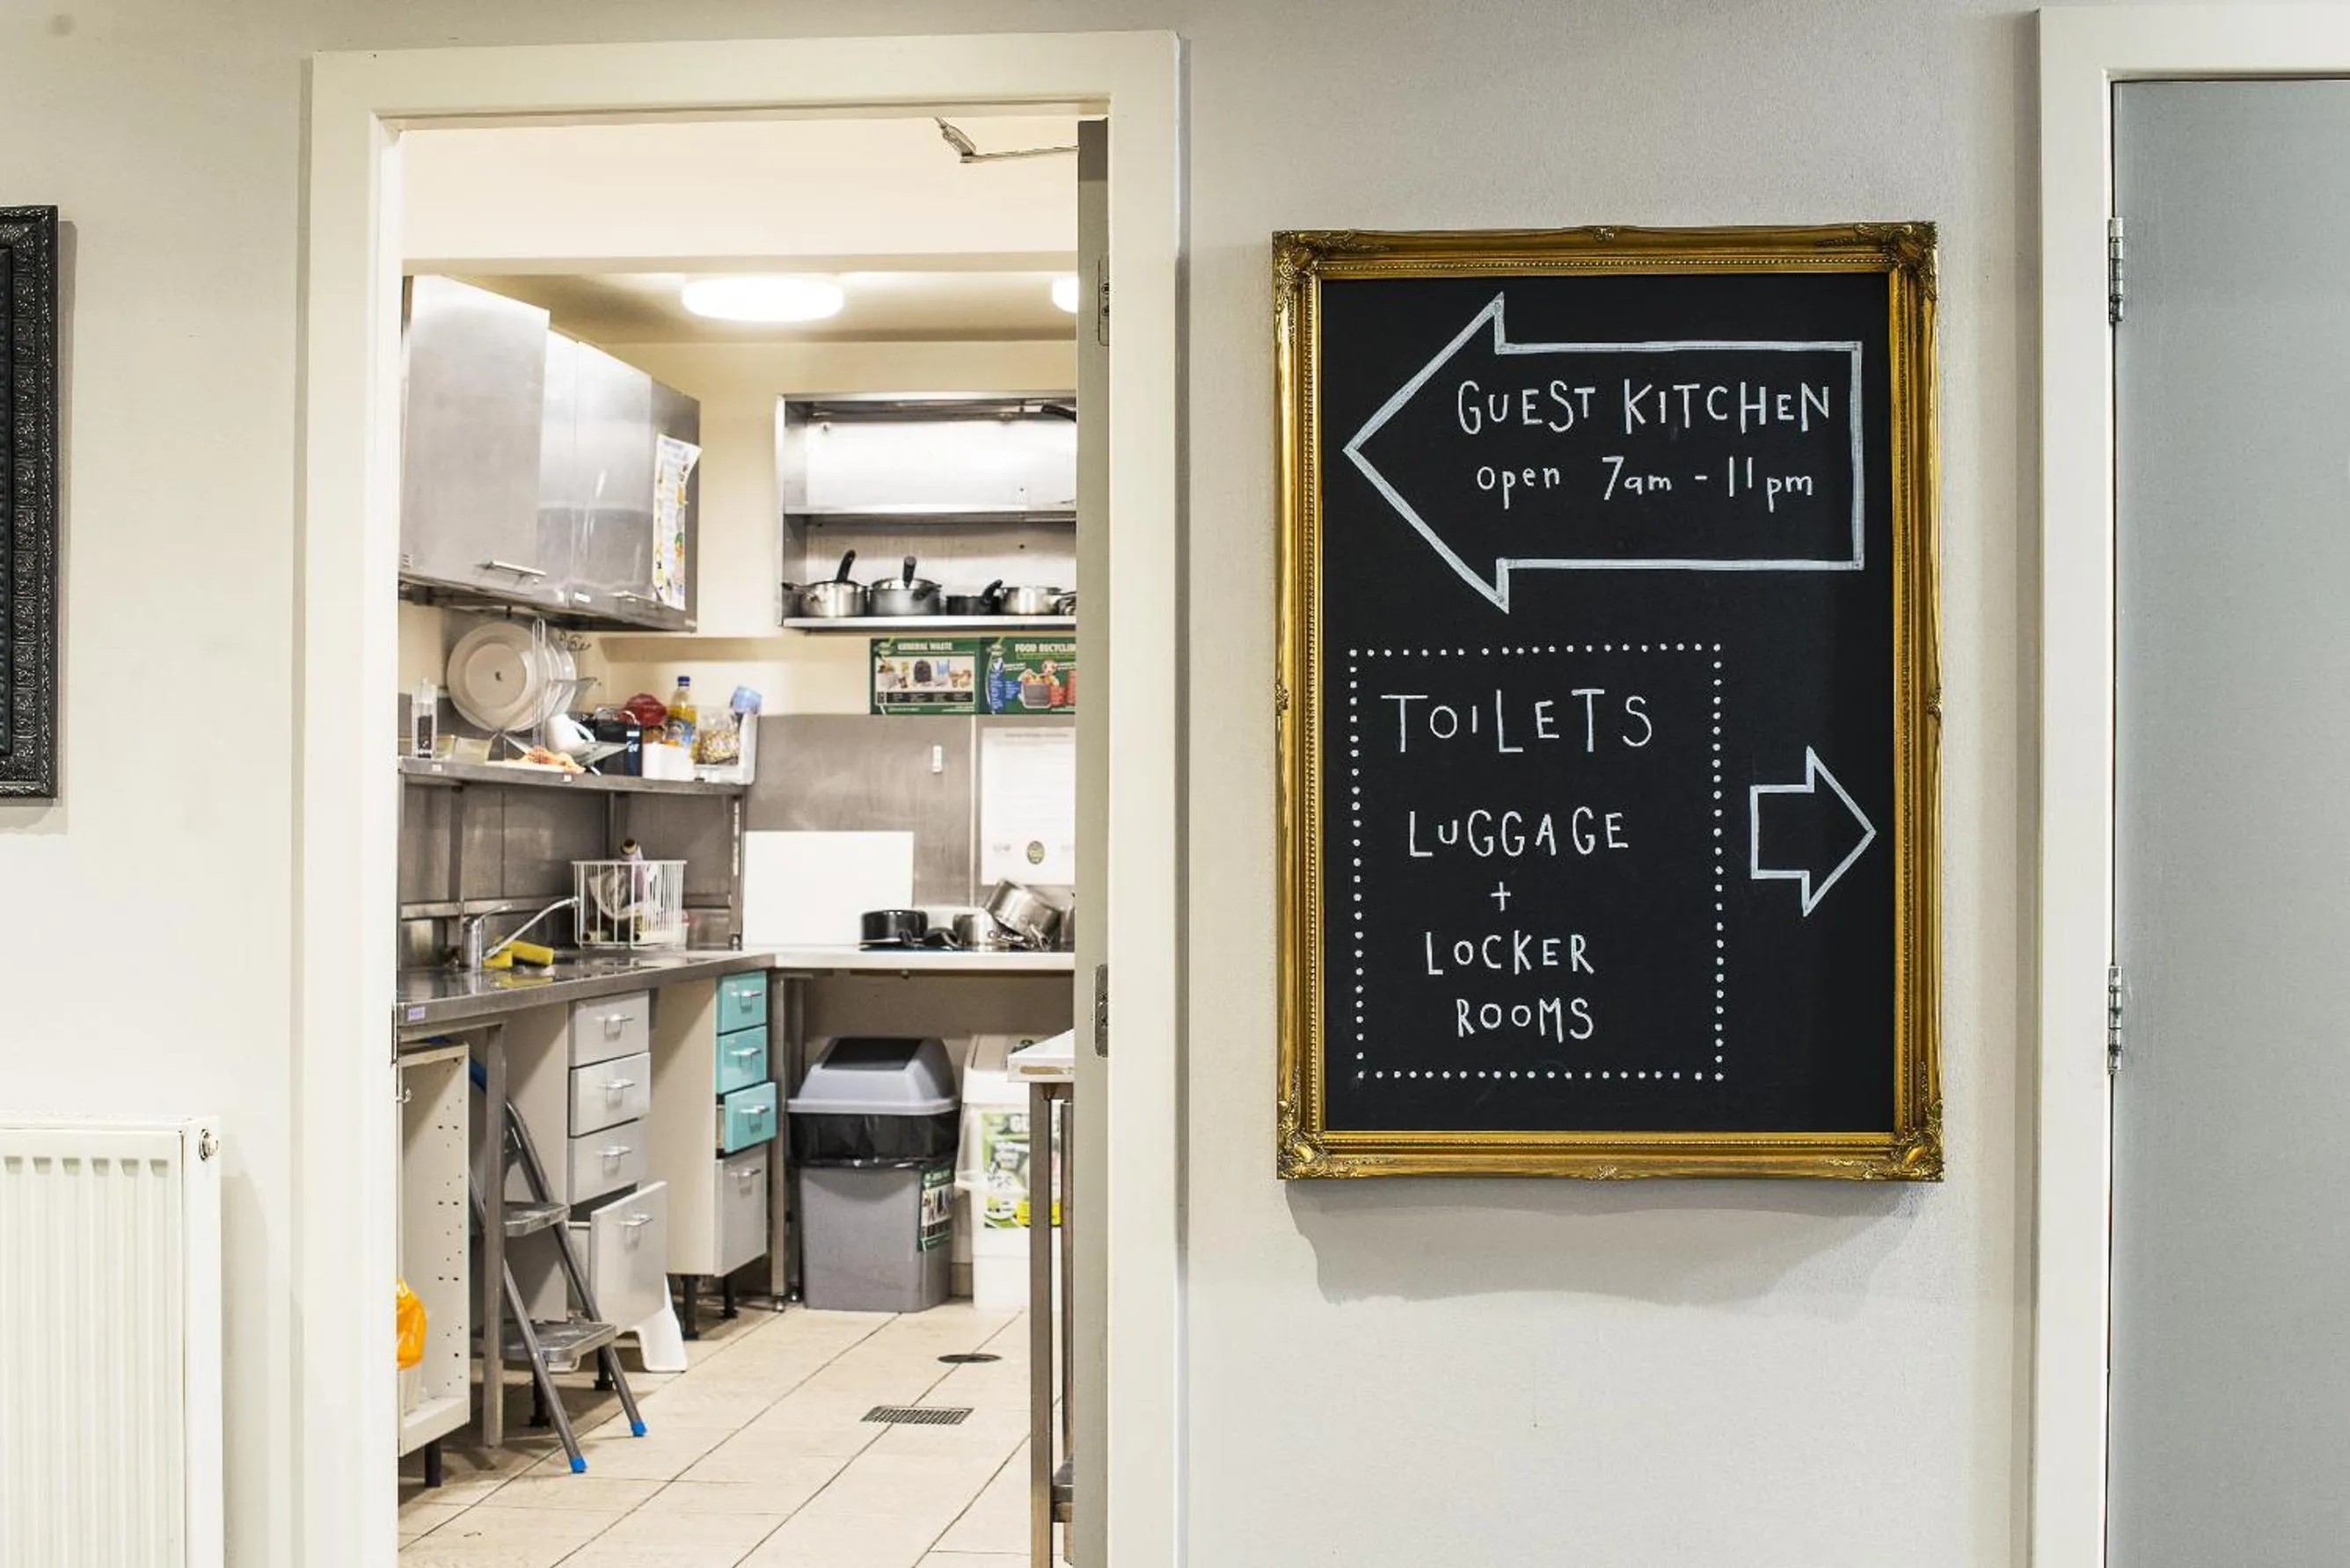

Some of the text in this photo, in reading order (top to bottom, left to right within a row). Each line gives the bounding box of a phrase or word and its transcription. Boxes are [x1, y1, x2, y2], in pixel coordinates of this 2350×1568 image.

[1457, 378, 1829, 435] GUEST KITCHEN
[1477, 466, 1560, 510] open
[1602, 456, 1673, 500] 7am
[1015, 643, 1076, 653] FOOD RECYCLIN
[1380, 688, 1653, 753] TOILETS
[1409, 806, 1629, 857] LUGGAGE
[1490, 881, 1512, 912] +
[1426, 930, 1595, 975] LOCKER
[1456, 996, 1595, 1044] ROOMS
